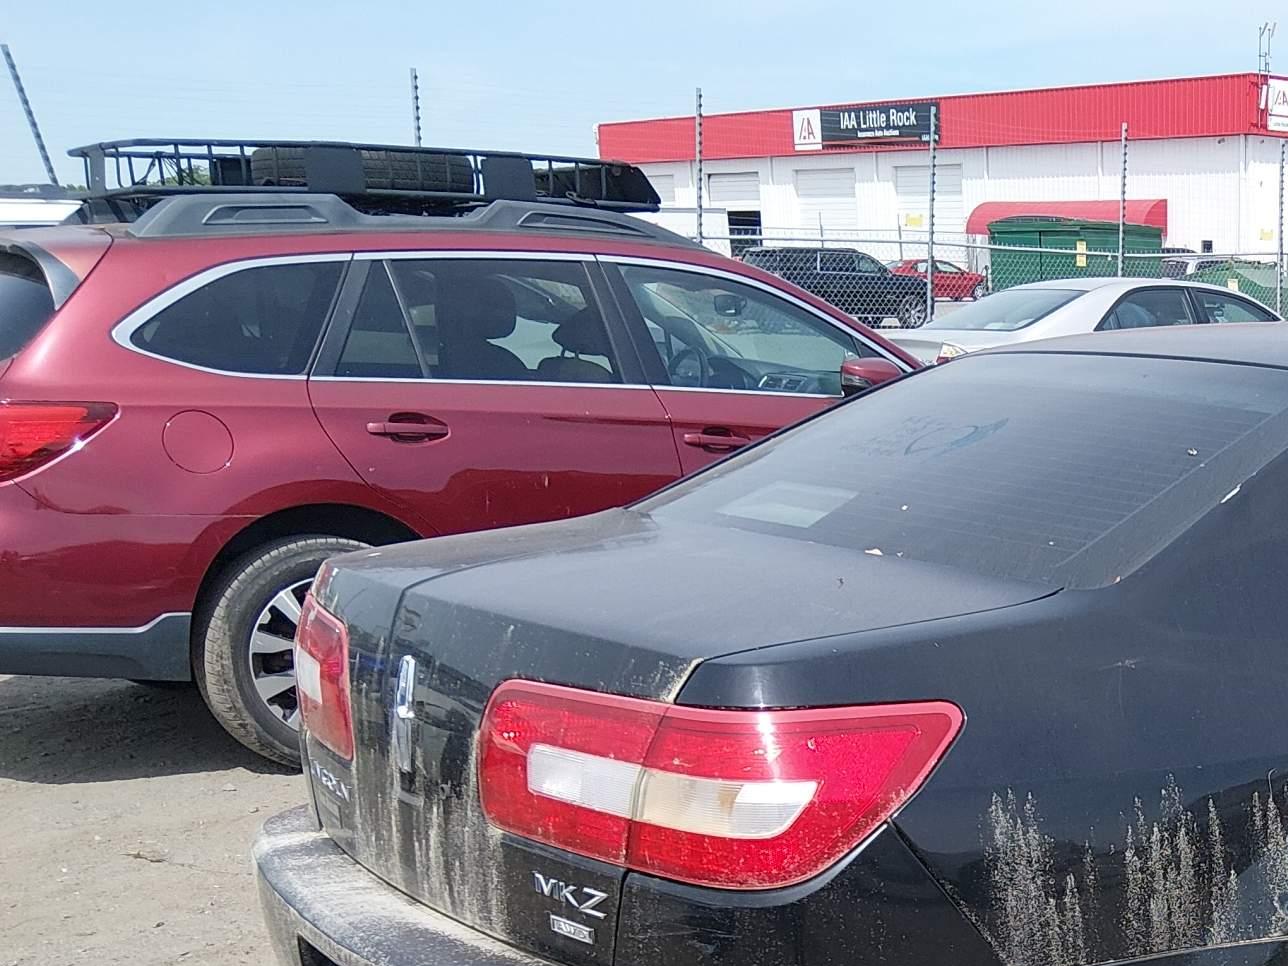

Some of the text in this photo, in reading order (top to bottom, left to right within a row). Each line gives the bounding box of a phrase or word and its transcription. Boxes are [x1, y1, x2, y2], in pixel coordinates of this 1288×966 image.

[840, 107, 917, 130] IAA Little Rock
[532, 871, 609, 919] MKZ
